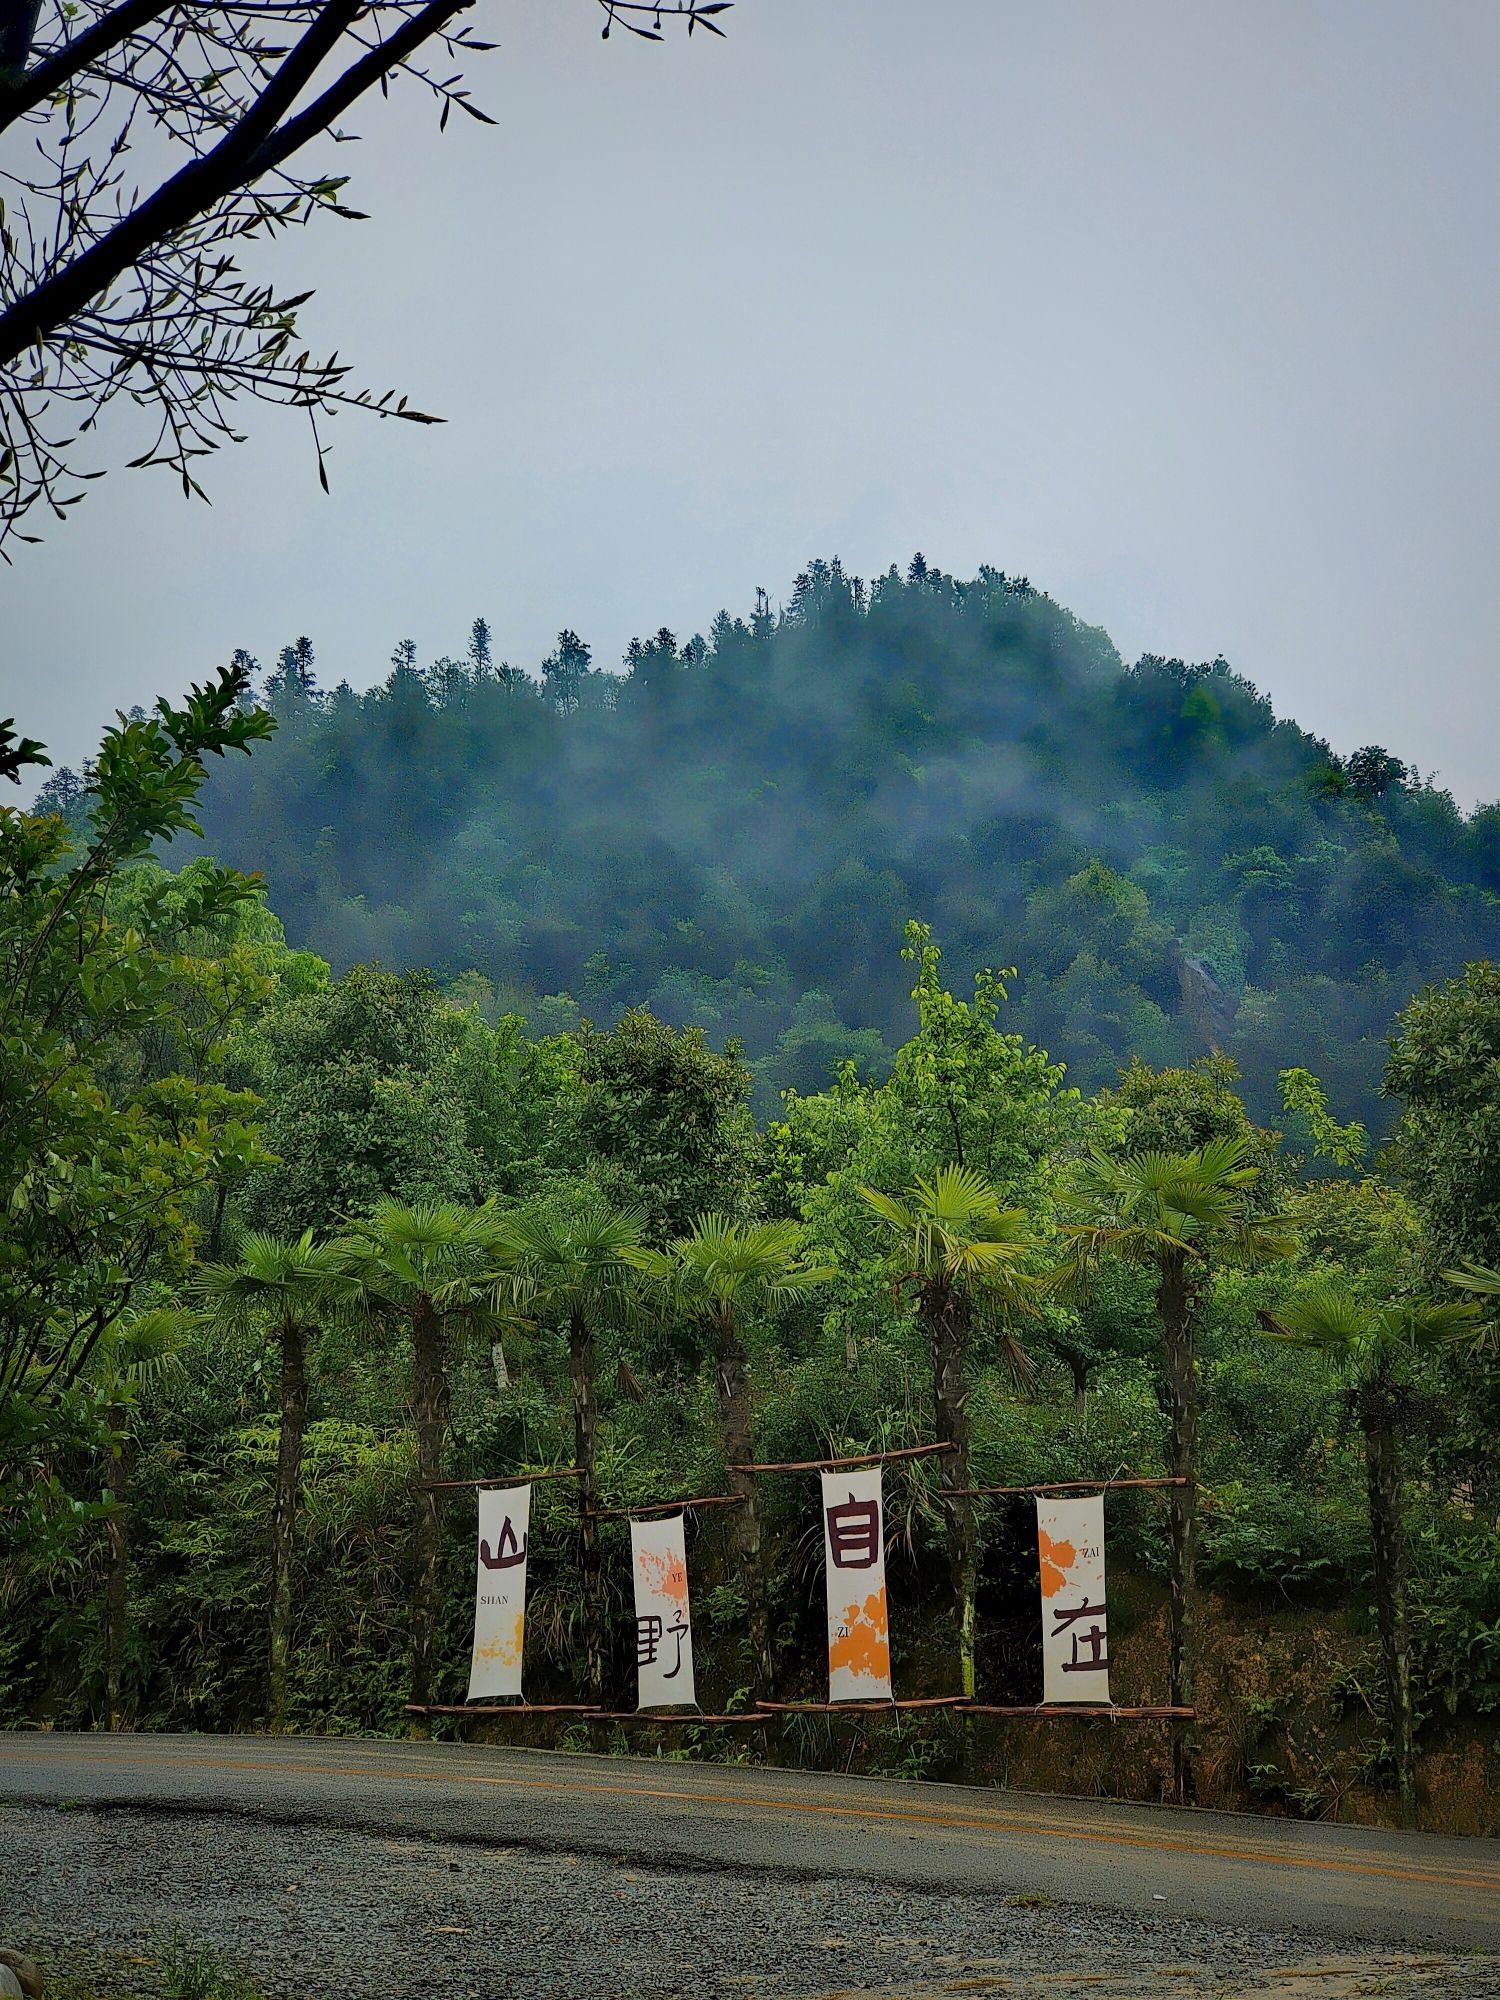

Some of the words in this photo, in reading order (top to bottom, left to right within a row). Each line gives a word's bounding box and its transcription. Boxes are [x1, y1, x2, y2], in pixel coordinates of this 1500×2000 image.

[480, 1516, 527, 1570] 山
[826, 1491, 879, 1569] 自
[1082, 1547, 1099, 1558] ZAI
[671, 1572, 683, 1583] YE
[480, 1595, 508, 1605] SHAN
[637, 1610, 688, 1679] 野
[837, 1626, 849, 1638] ZI
[1051, 1597, 1109, 1672] 在
